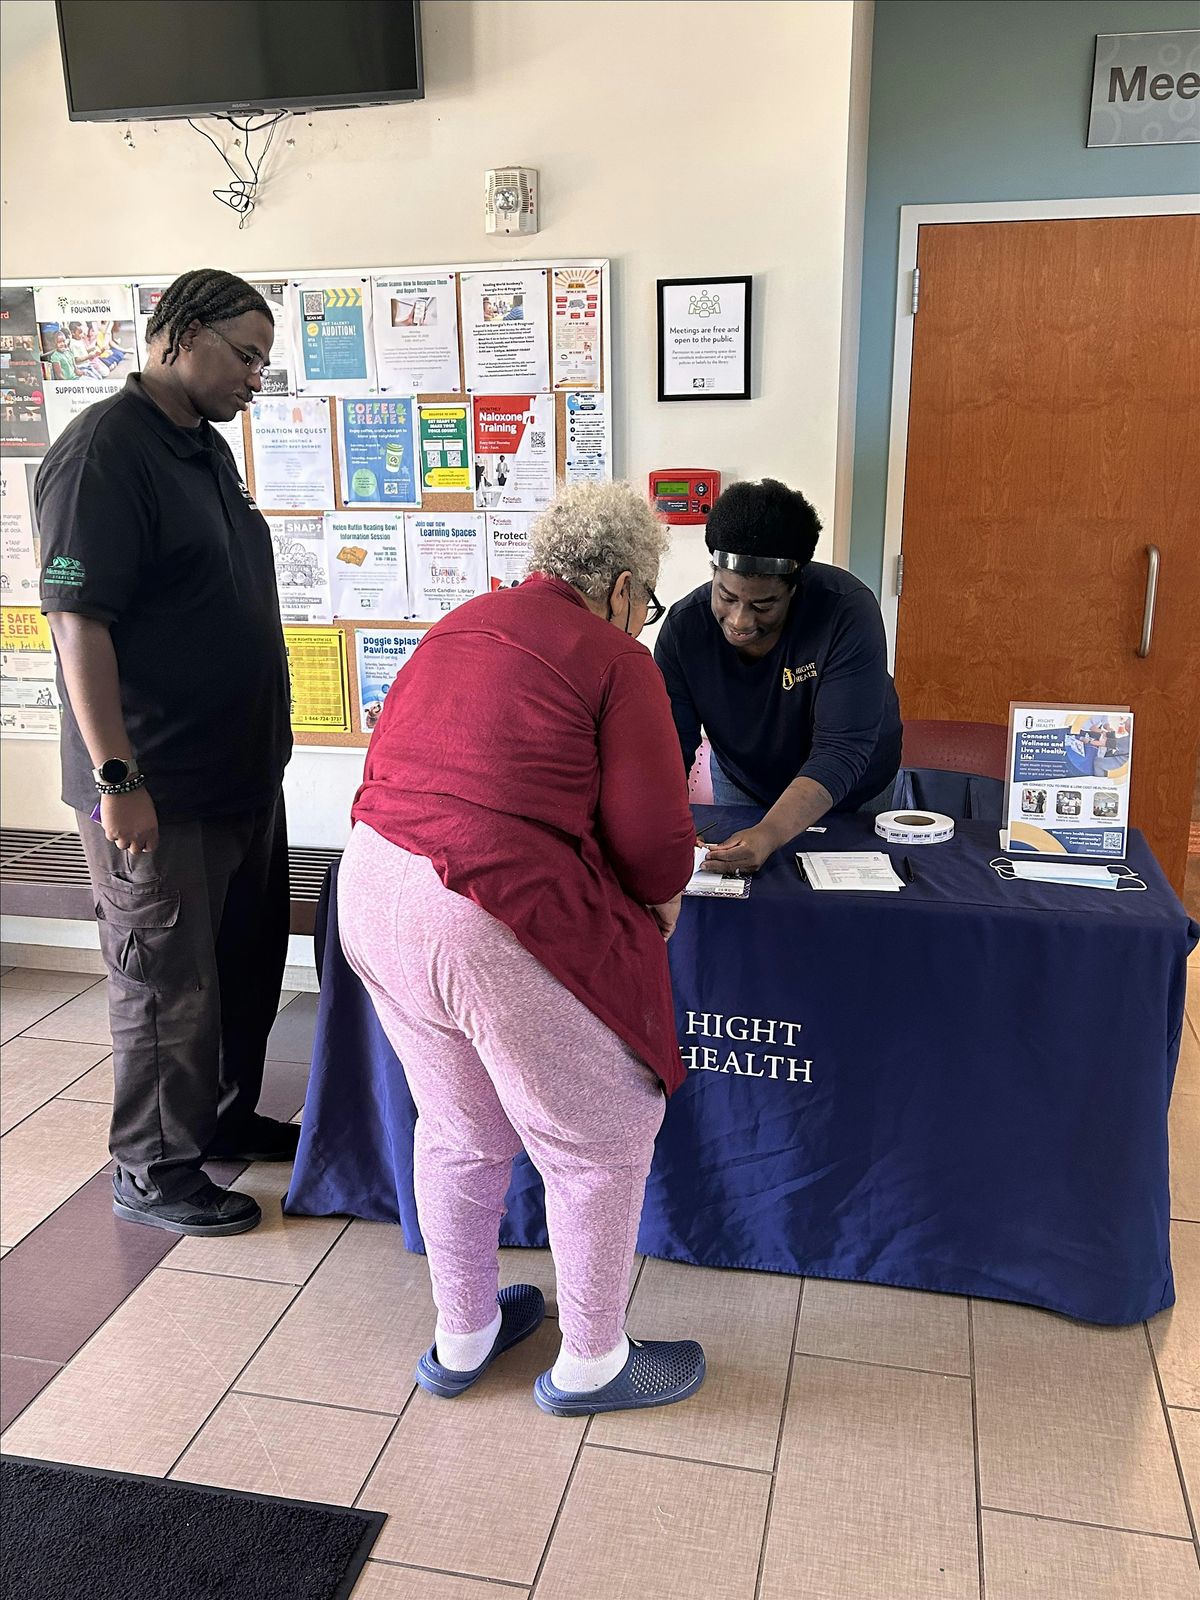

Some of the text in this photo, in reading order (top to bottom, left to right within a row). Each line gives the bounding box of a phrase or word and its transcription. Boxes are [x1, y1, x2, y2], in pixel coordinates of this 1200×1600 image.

[1108, 66, 1200, 103] Mee
[71, 306, 111, 314] FOUNDATION
[322, 325, 356, 337] AUDITION!
[670, 327, 700, 335] Meetings
[713, 325, 726, 333] free
[727, 325, 739, 333] and
[713, 335, 734, 344] public.
[55, 386, 84, 394] SUPPORT
[86, 386, 103, 394] YOUR
[348, 413, 397, 425] CREATE
[479, 412, 523, 421] Naloxone
[479, 423, 517, 435] Training
[286, 523, 322, 533] SNAP?
[363, 524, 384, 532] Reading
[419, 528, 476, 538] Learning Spaces
[493, 530, 527, 540] Protect
[431, 568, 460, 577] LEARNING
[431, 576, 461, 584] SPACES
[7, 613, 37, 624] SAFE
[8, 626, 39, 635] SEEN
[363, 645, 406, 655] Pawlooza!
[1022, 732, 1050, 740] Connect
[1041, 747, 1068, 757] Healthy
[685, 1011, 802, 1046] HIGHT
[679, 1046, 813, 1083] HEALTH
